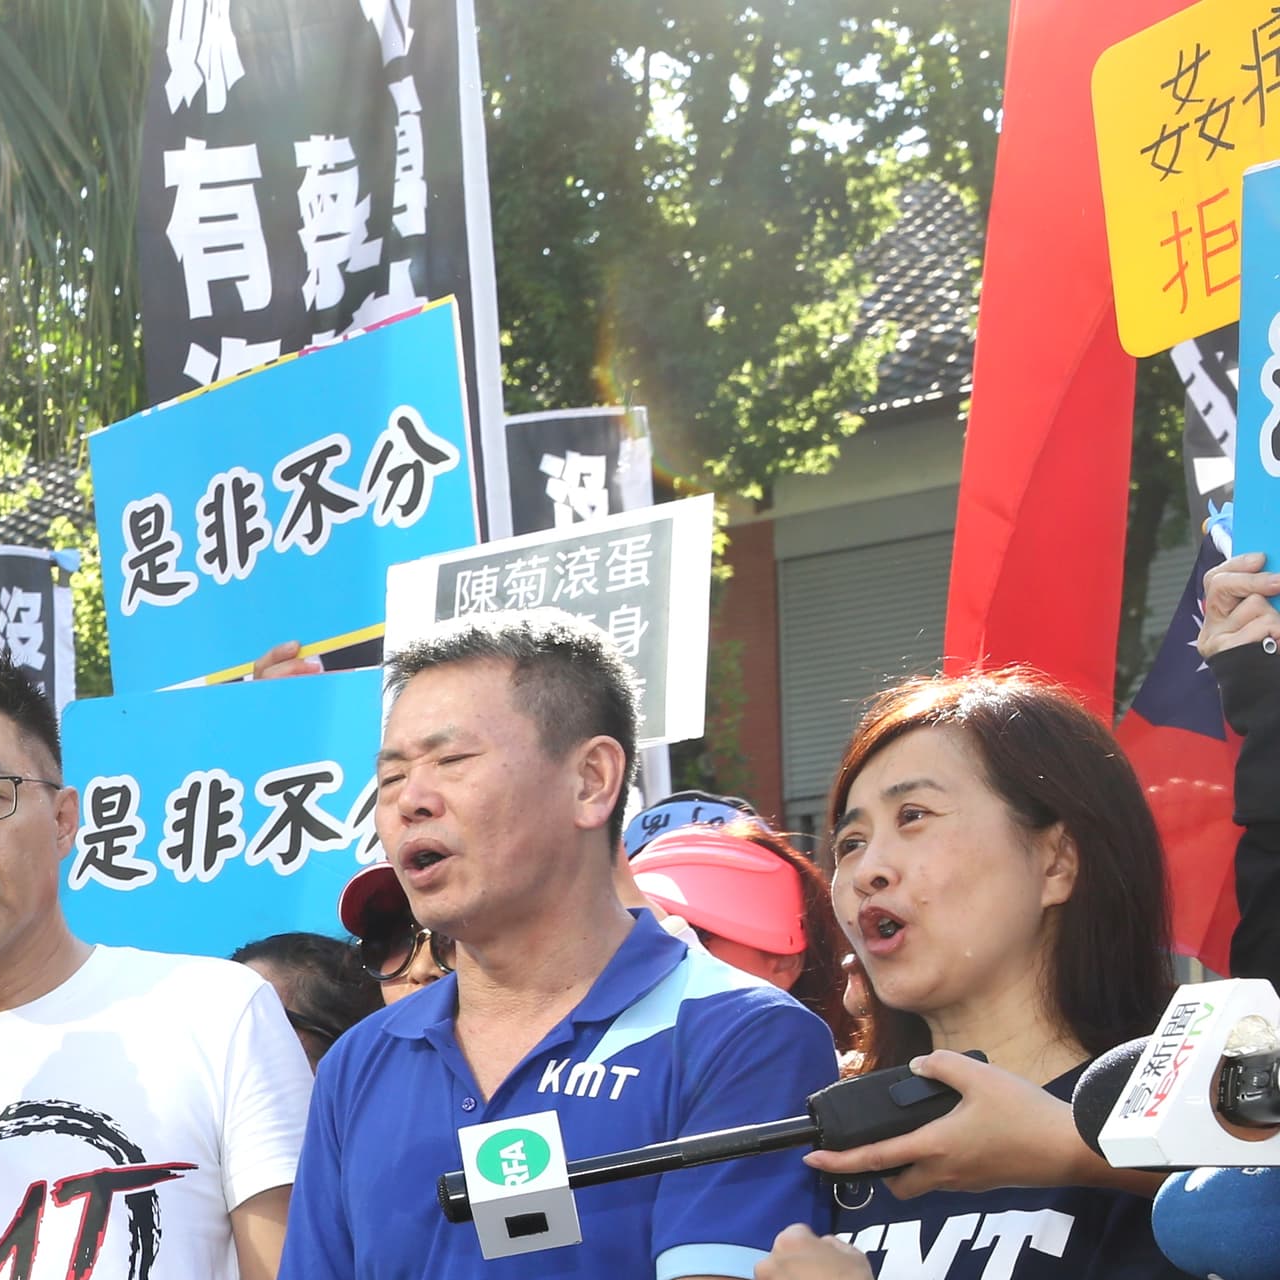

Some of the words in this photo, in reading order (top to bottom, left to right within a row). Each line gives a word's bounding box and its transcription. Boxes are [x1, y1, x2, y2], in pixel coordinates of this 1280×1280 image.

[126, 412, 452, 606] 是非不分
[454, 533, 653, 618] 陳菊滾蛋
[537, 1057, 640, 1101] KMT
